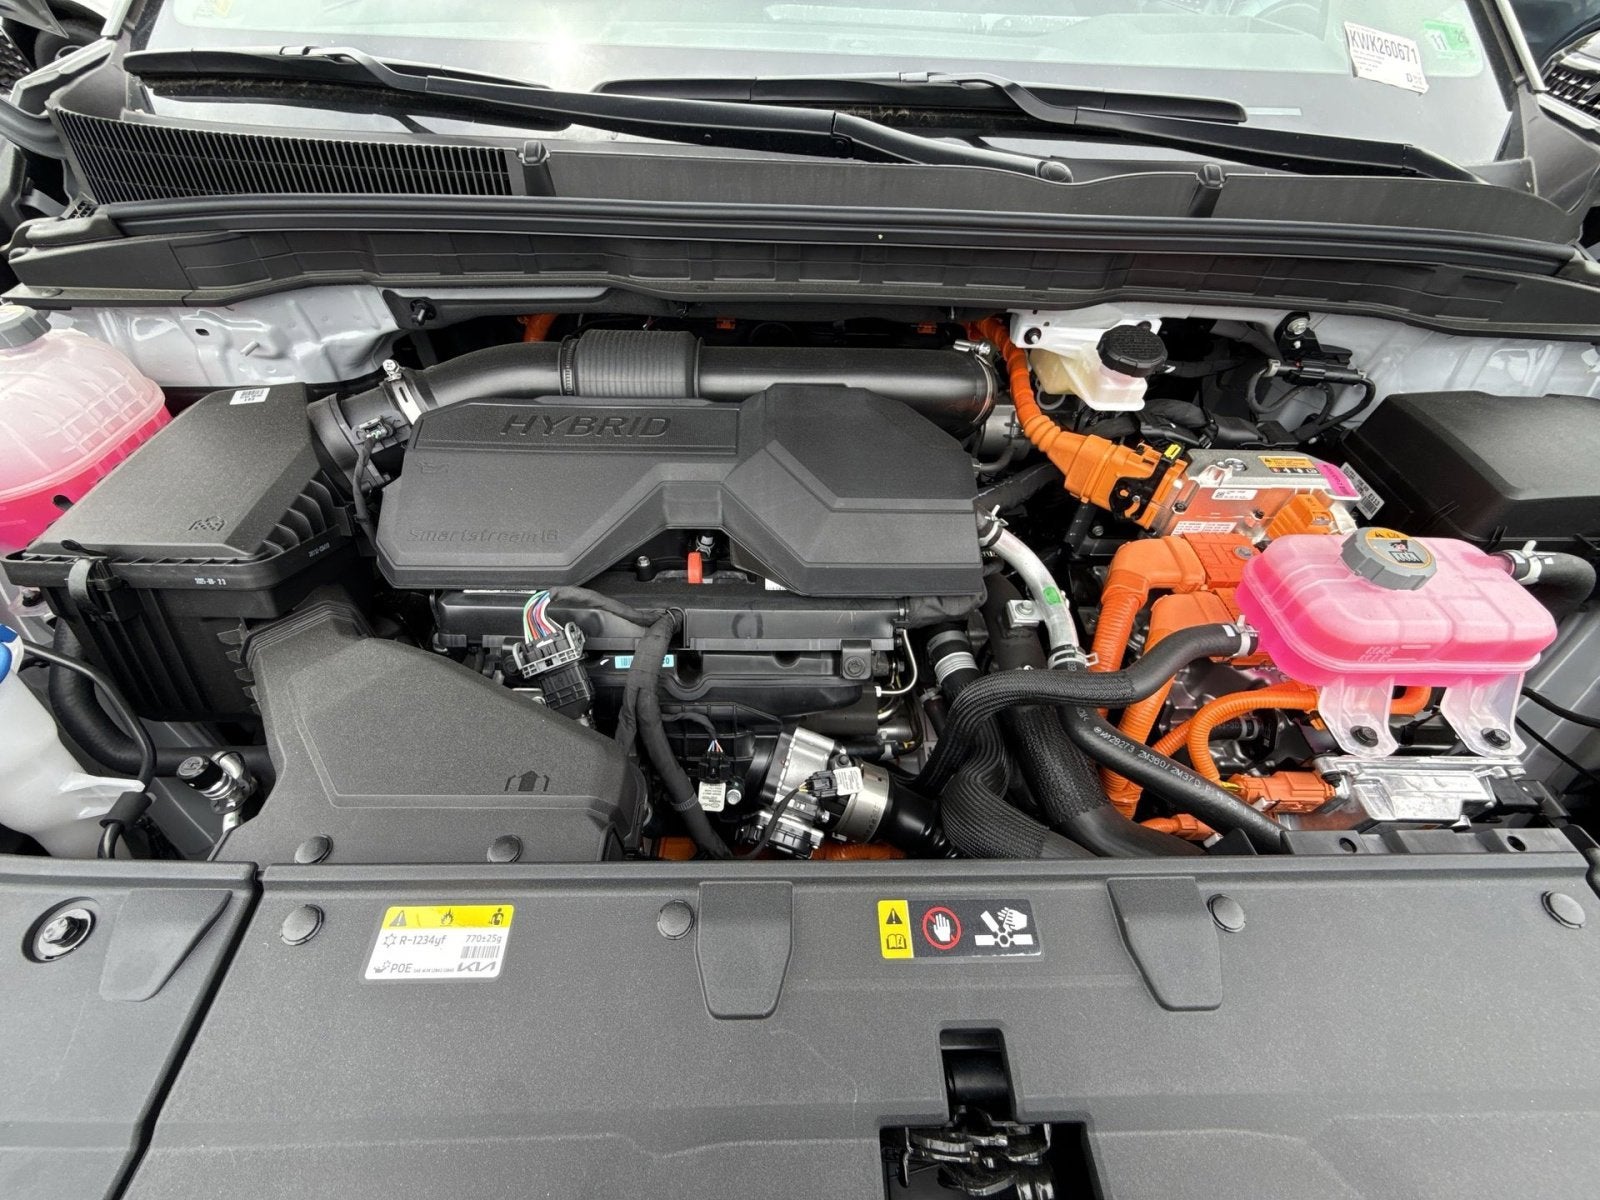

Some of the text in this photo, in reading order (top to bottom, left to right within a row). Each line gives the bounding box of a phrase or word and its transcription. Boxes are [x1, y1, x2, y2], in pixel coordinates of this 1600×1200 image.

[1349, 29, 1418, 65] KWK260671
[500, 414, 671, 438] HYBRID
[399, 934, 503, 948] R-1234yf 770±25g
[390, 963, 413, 974] POE
[456, 961, 497, 973] KIA
